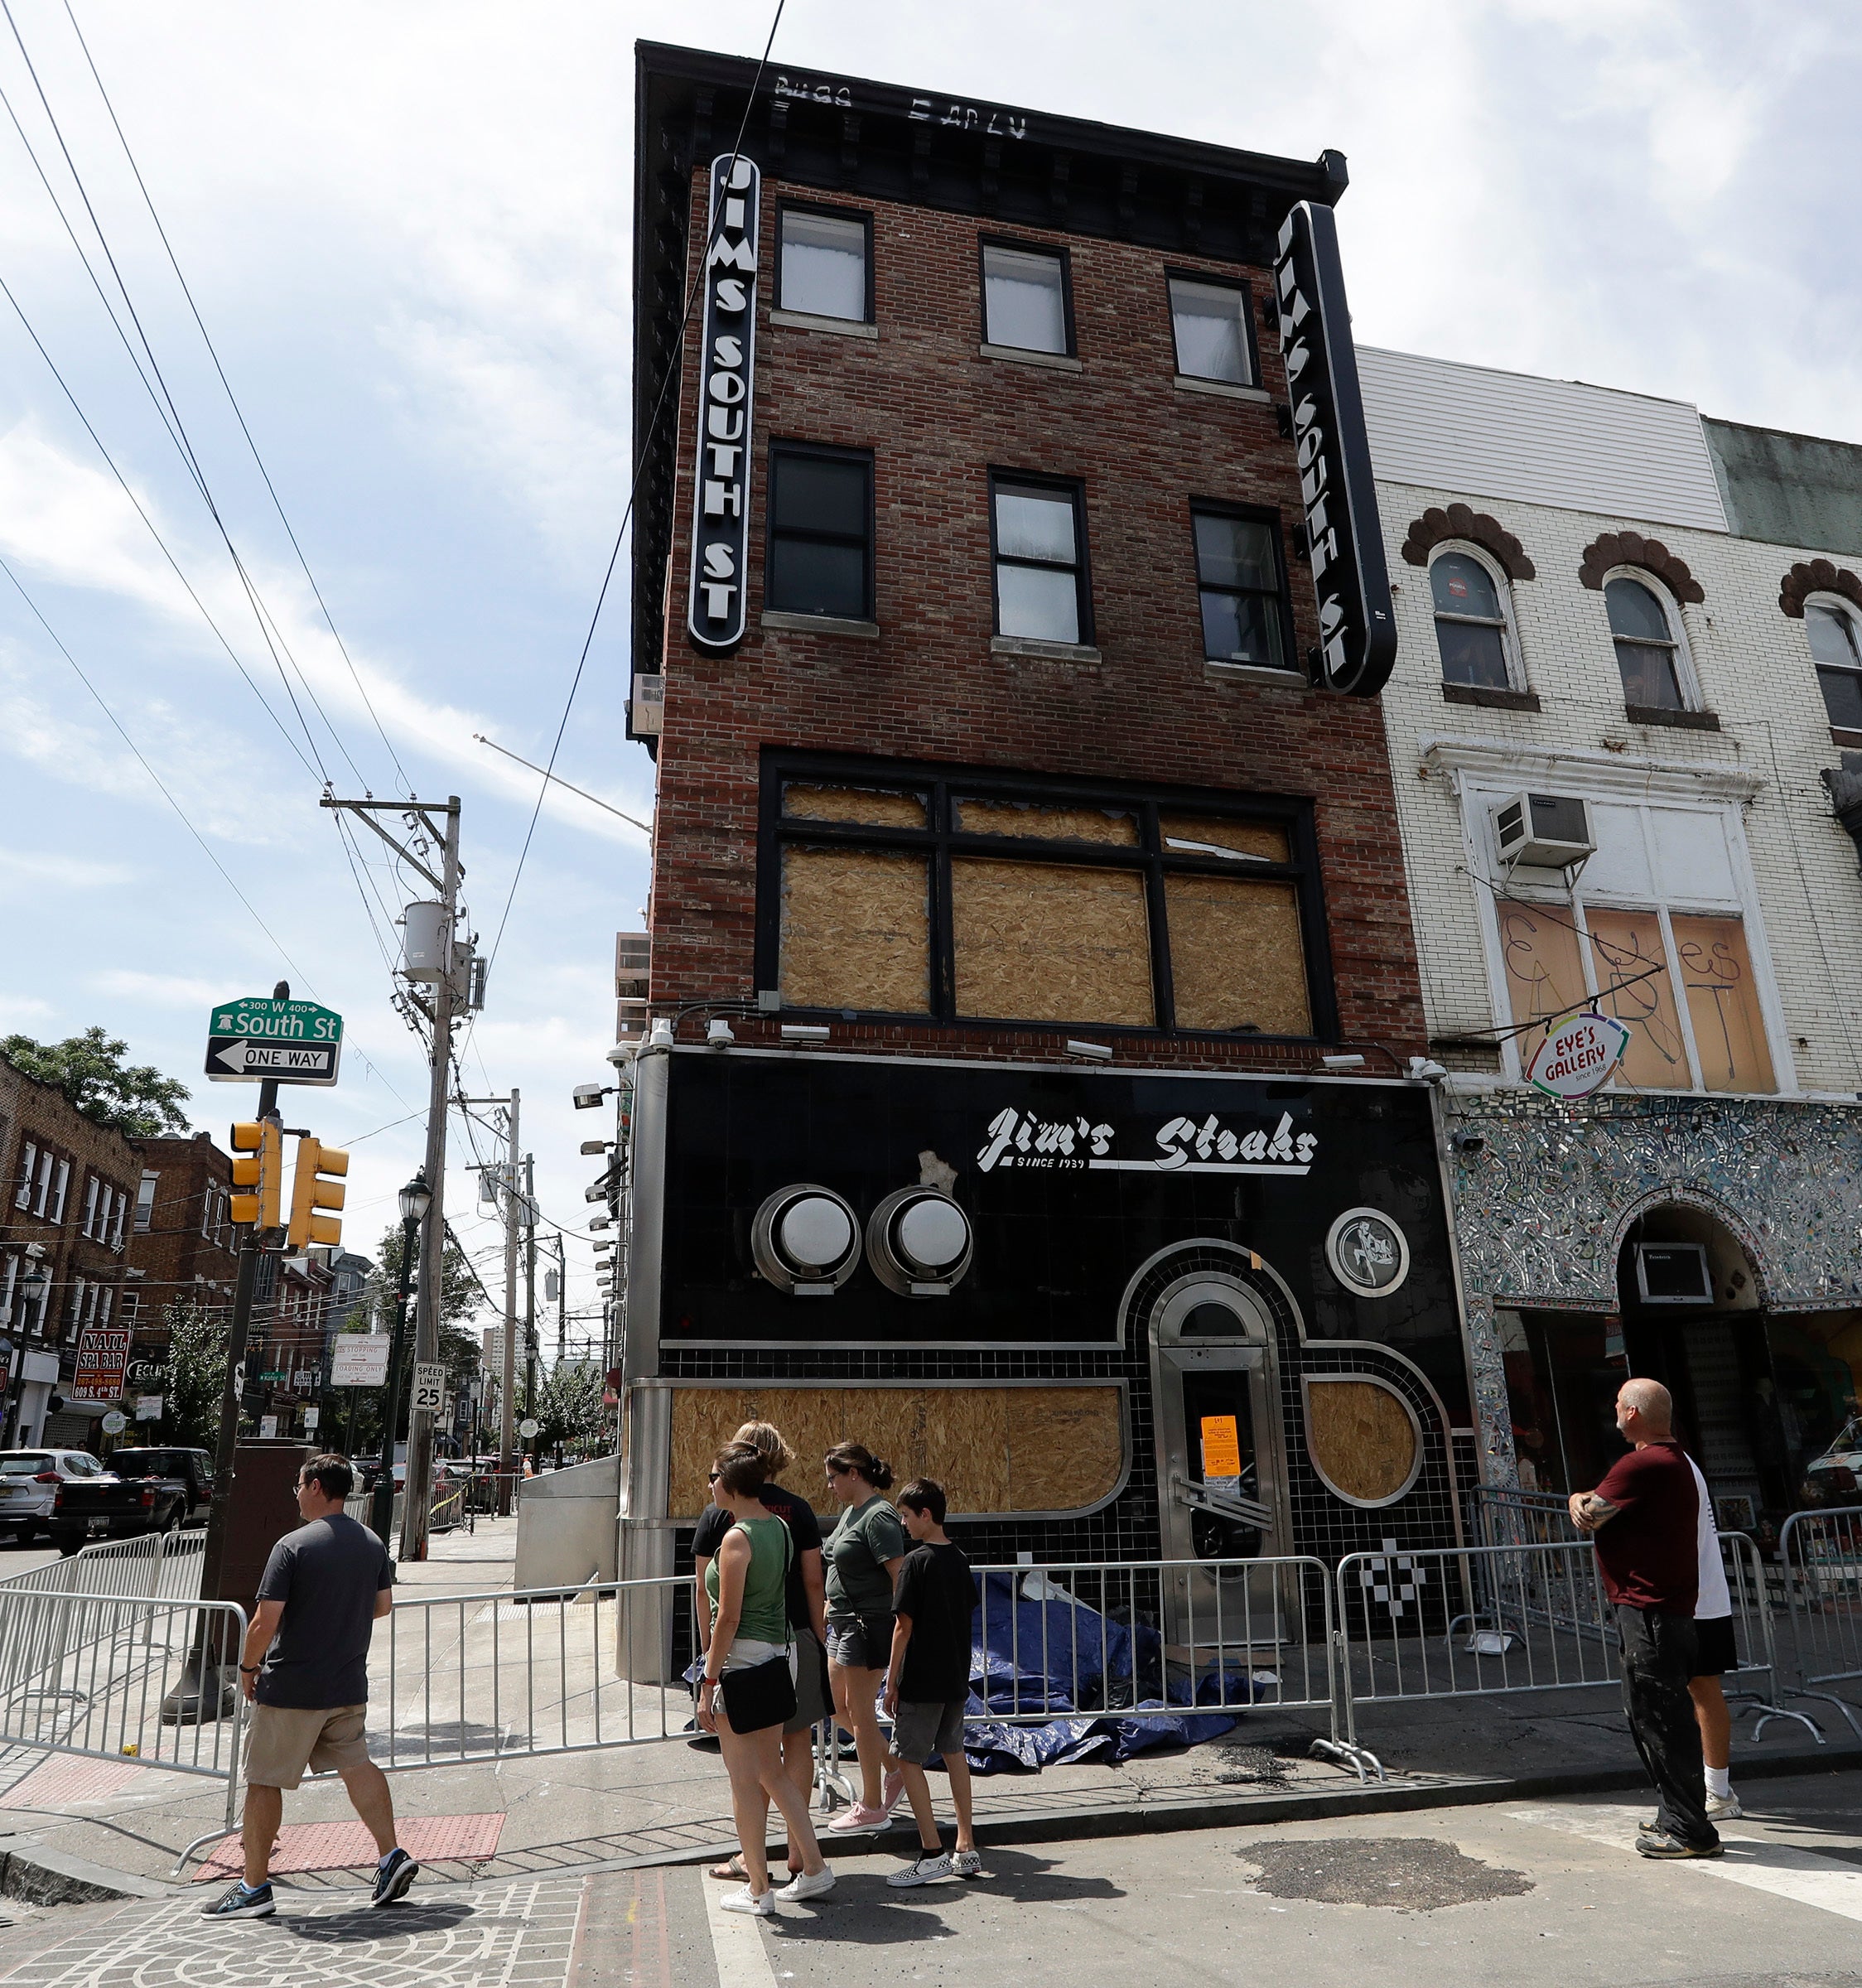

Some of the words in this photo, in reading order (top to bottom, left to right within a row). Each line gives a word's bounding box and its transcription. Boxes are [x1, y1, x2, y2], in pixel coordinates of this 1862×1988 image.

[705, 335, 745, 517] SOUTH
[1295, 393, 1339, 583] SOUTH
[1320, 593, 1348, 675] ST
[700, 543, 737, 619] ST
[249, 1001, 268, 1010] 300
[272, 1001, 286, 1013] W
[289, 1004, 307, 1013] 400
[234, 1012, 304, 1037] South
[313, 1017, 336, 1039] St
[1556, 1025, 1595, 1057] EYE'S
[245, 1049, 281, 1065] ONE
[289, 1051, 322, 1067] WAY
[1545, 1044, 1605, 1081] GALLERY
[1575, 1071, 1590, 1082] since
[1592, 1064, 1607, 1076] 1968
[977, 1107, 1115, 1172] Jim's
[1155, 1110, 1318, 1170] Steaks
[1017, 1156, 1054, 1169] SINCE
[1059, 1158, 1084, 1170] 1939
[82, 1333, 127, 1351] NAIL
[80, 1352, 99, 1369] SPA
[100, 1352, 123, 1369] BAR
[417, 1367, 443, 1377] SPEED
[419, 1378, 440, 1387] LIMIT
[75, 1387, 88, 1398] 609
[88, 1386, 95, 1398] S.
[96, 1386, 109, 1398] 4th
[109, 1386, 119, 1398] ST.
[417, 1388, 440, 1407] 25
